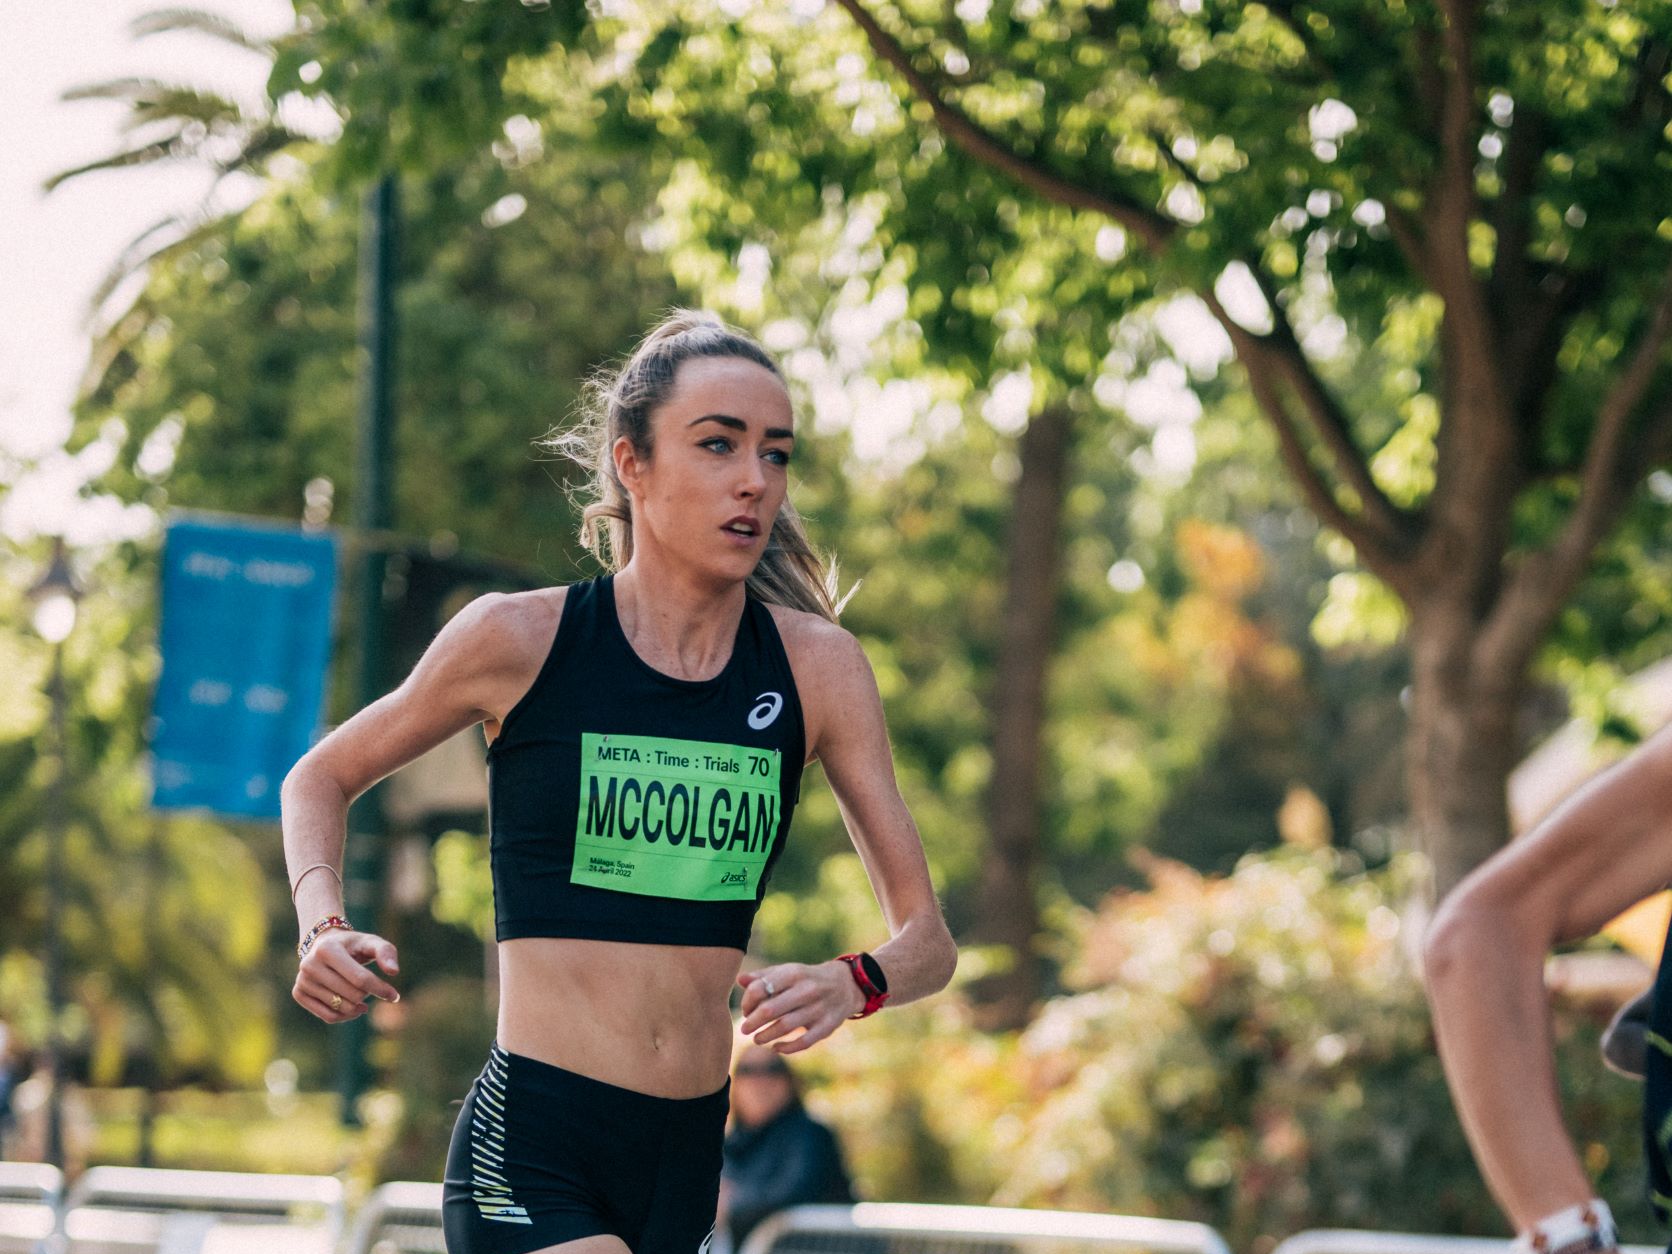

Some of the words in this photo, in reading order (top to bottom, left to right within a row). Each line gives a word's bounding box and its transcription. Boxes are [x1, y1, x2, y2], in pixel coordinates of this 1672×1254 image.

[598, 746, 641, 763] META
[655, 751, 690, 768] Time
[703, 756, 740, 773] Trials
[748, 756, 769, 777] 70
[585, 775, 775, 853] MCCOLGAN
[615, 868, 631, 877] 2022
[616, 860, 635, 870] Spain
